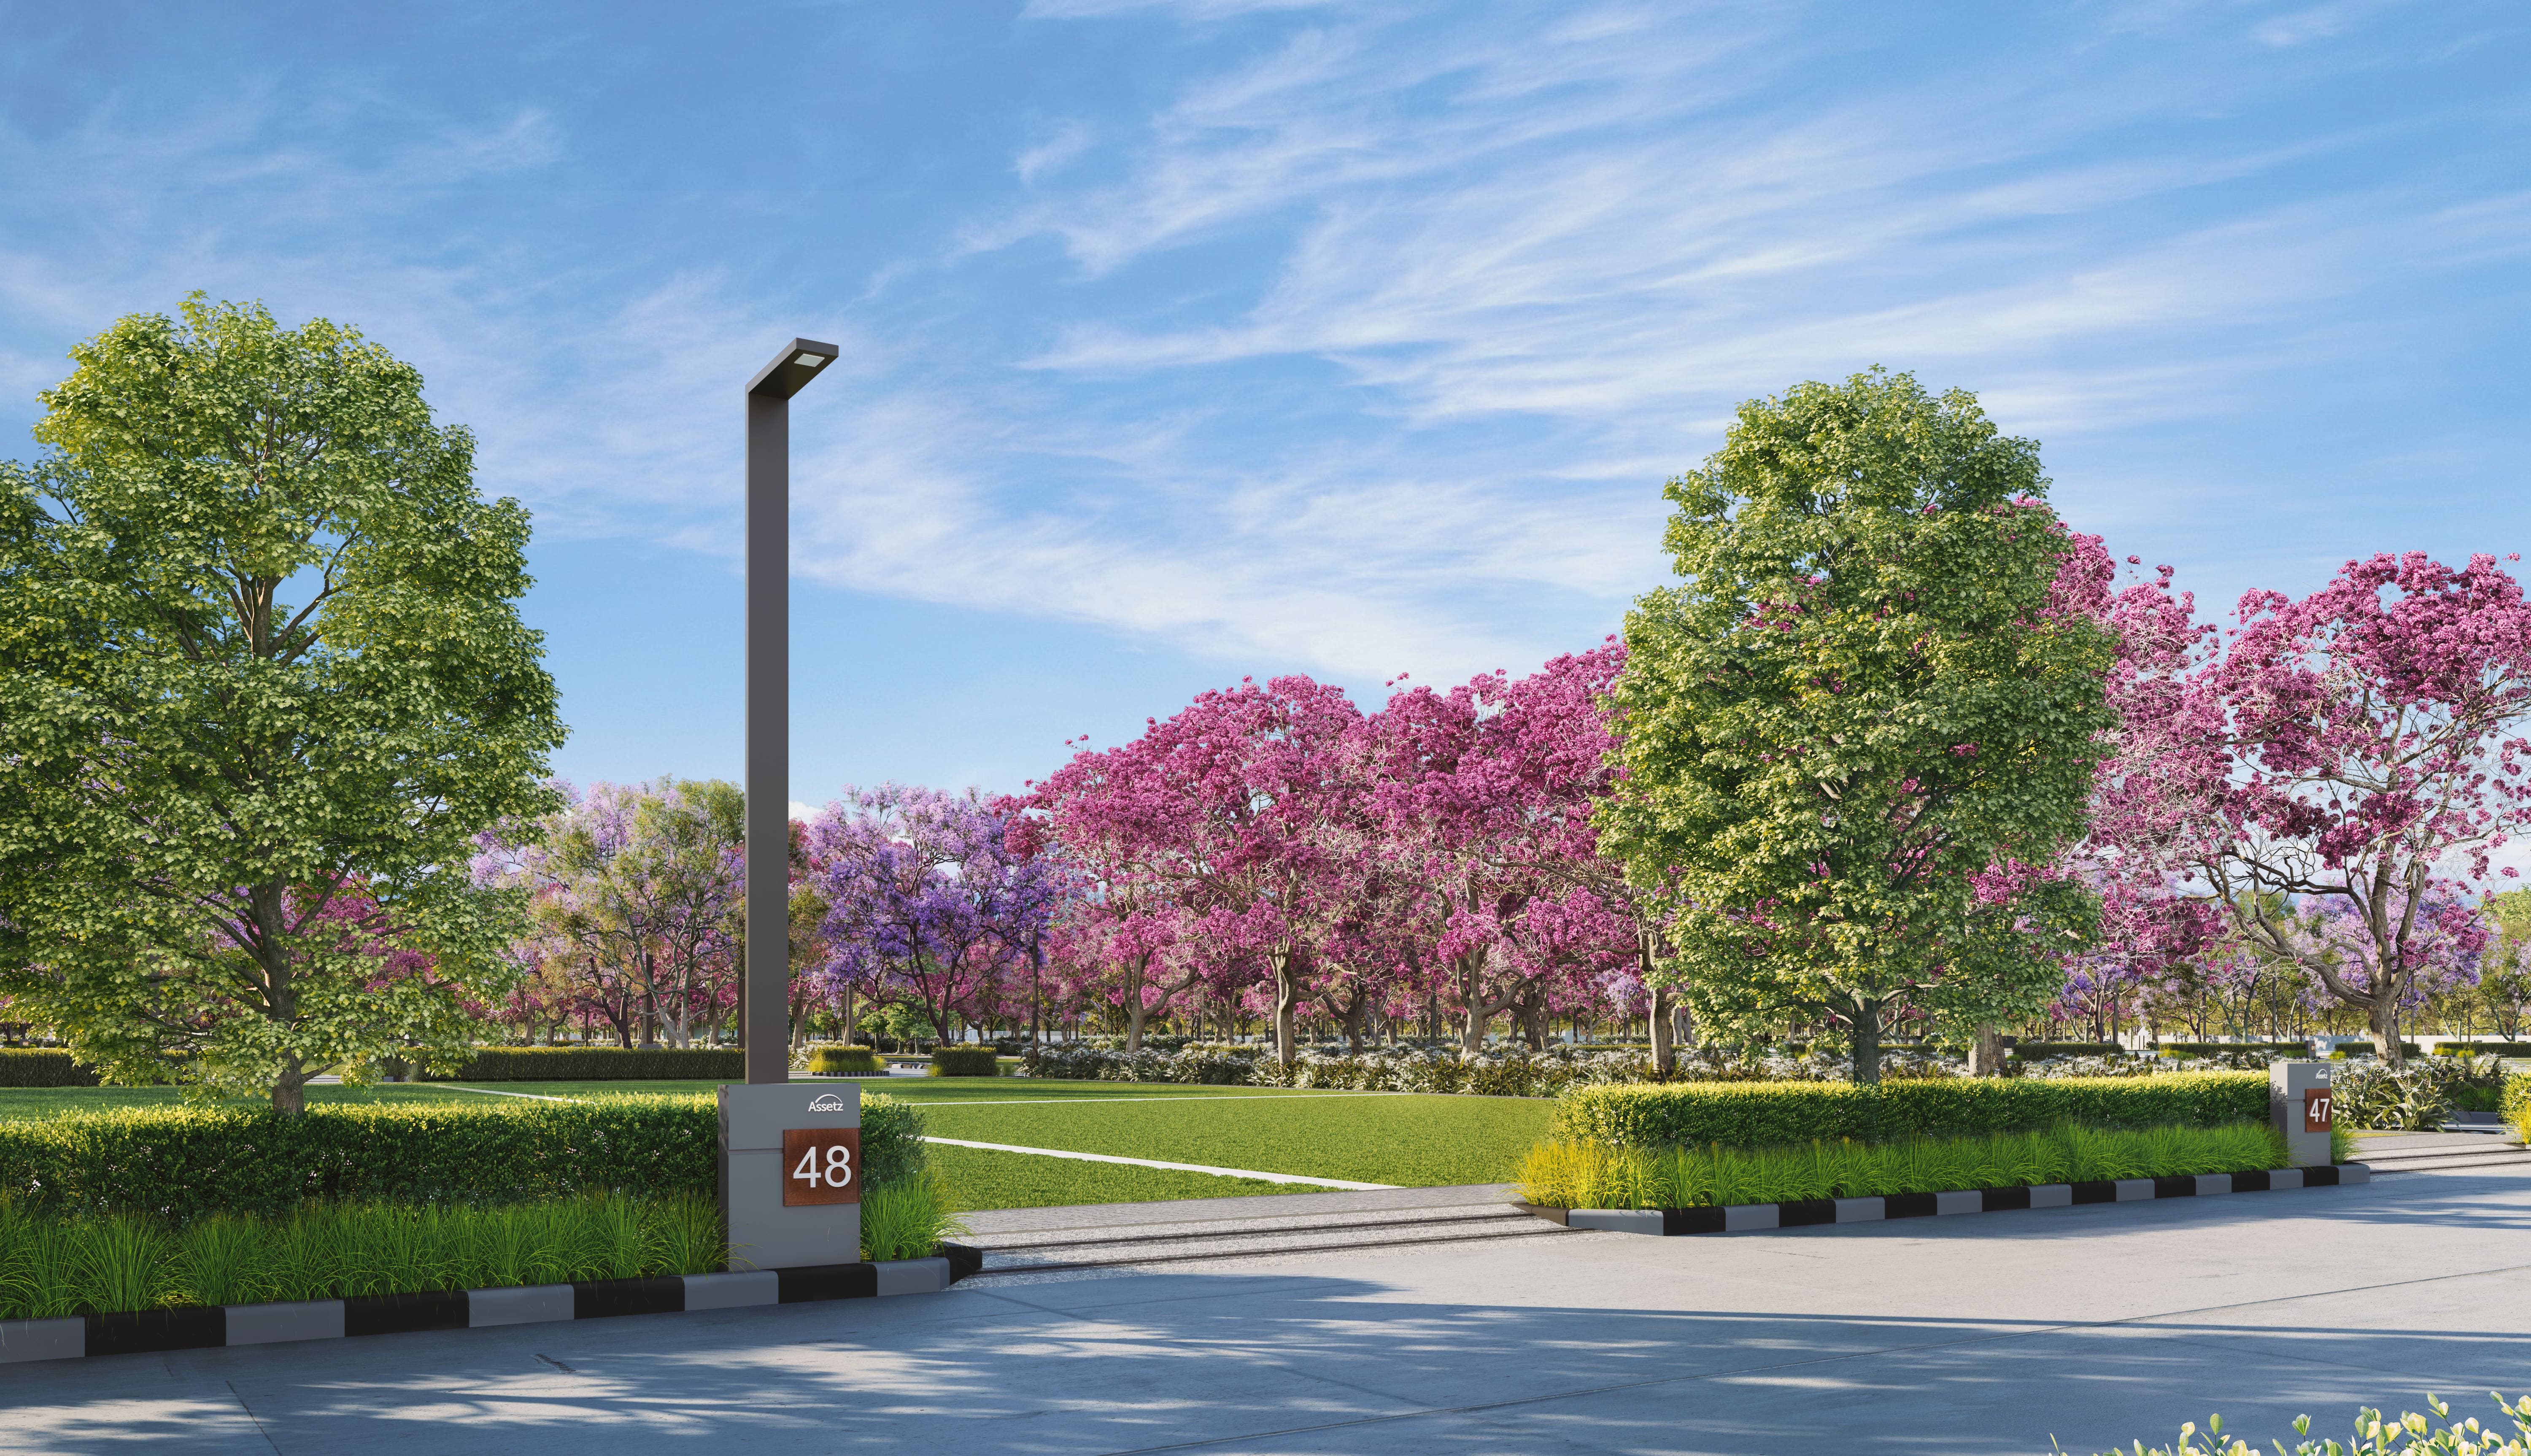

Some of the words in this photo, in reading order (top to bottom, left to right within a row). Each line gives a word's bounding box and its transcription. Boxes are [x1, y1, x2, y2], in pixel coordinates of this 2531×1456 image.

[808, 1101, 843, 1112] Assetz
[2309, 1098, 2330, 1122] 47
[793, 1145, 851, 1188] 48
